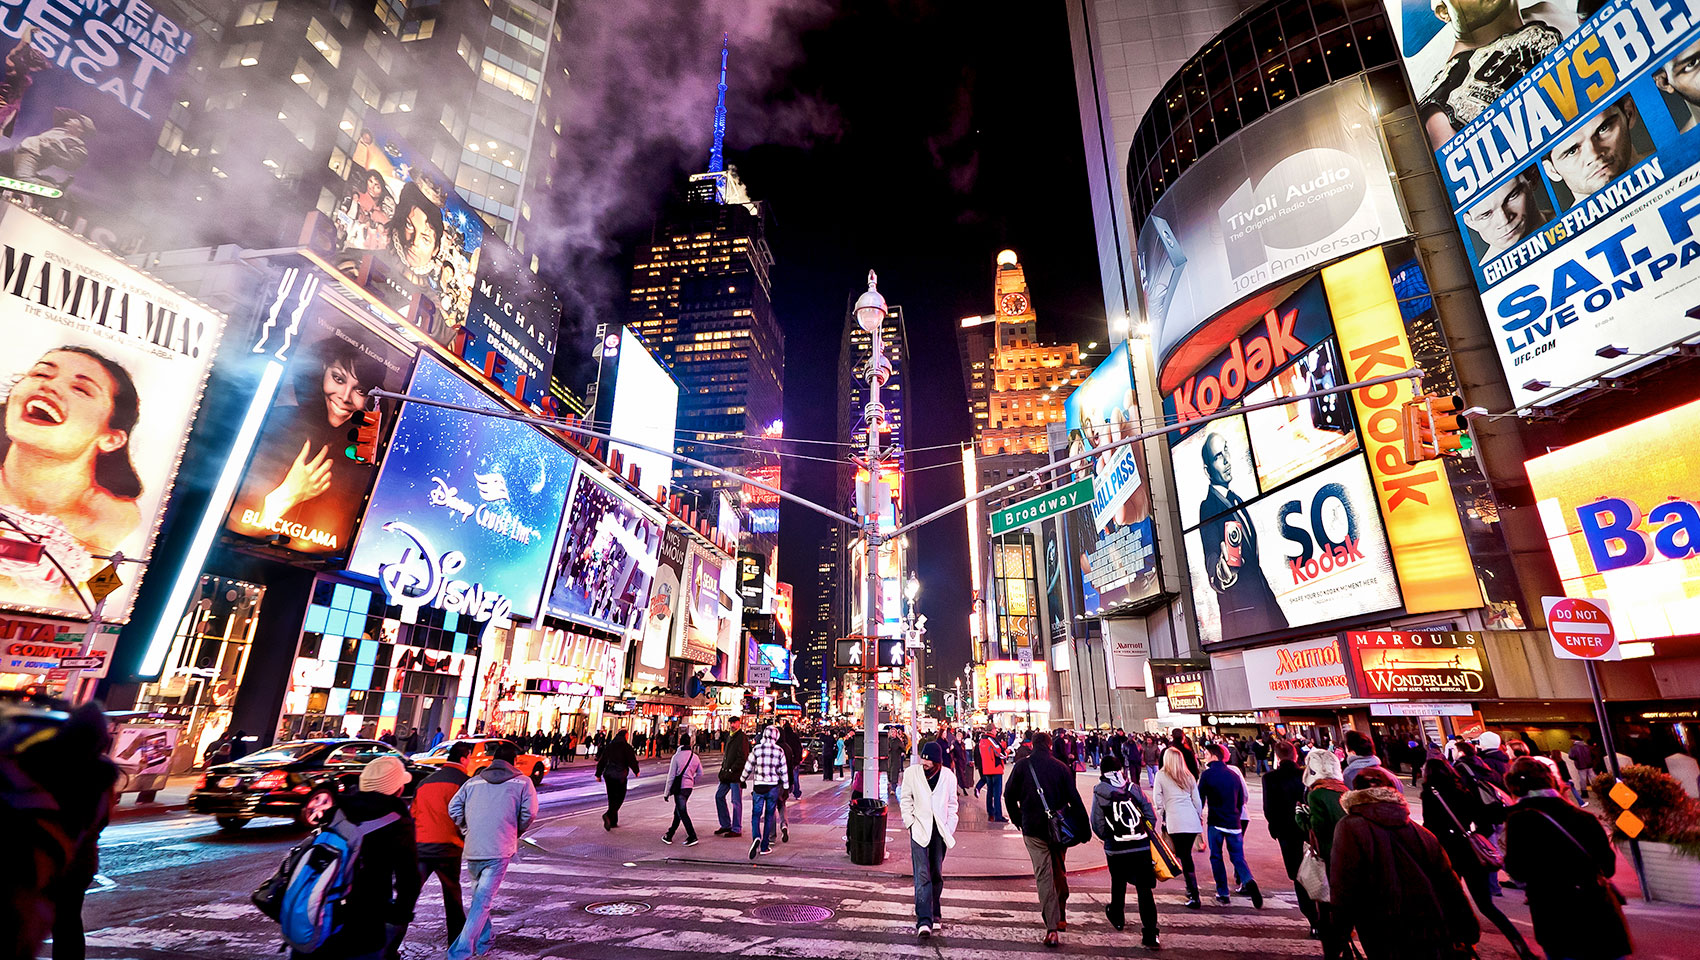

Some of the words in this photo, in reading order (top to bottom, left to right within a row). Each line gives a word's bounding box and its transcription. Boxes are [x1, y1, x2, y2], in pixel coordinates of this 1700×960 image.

[2, 0, 170, 91] EST
[107, 0, 191, 54] ER!
[111, 13, 178, 64] AWARD
[1441, 108, 1496, 156] WORLD
[1446, 86, 1564, 204] SILVA
[1538, 35, 1617, 123] VS
[1227, 194, 1278, 231] Tivoli
[1286, 166, 1351, 204] Audio
[1229, 229, 1244, 242] The
[1245, 214, 1278, 234] Original
[1279, 201, 1305, 217] Radio
[1306, 180, 1354, 204] Company
[1483, 230, 1549, 286] GRIFFIN
[1545, 222, 1568, 247] VS
[1561, 157, 1666, 238] FRANKLIN
[1620, 194, 1664, 223] PRESENTED
[1665, 186, 1676, 196] BY
[1678, 169, 1700, 189] BU
[1232, 270, 1267, 294] 10th
[1270, 226, 1381, 275] Anniversary
[1497, 224, 1652, 332] SAT.
[2, 244, 129, 334] MAMMA
[138, 300, 204, 359] MIA!
[24, 305, 41, 317] THE
[44, 310, 75, 327] SMASH
[479, 280, 554, 354] MICHAEL
[1506, 304, 1579, 354] LIVE
[1584, 270, 1644, 313] ON
[359, 343, 366, 351] A
[483, 313, 501, 335] THE
[501, 328, 521, 350] NEW
[519, 345, 545, 372] ALBUM
[486, 333, 529, 373] DECEMBER
[528, 367, 538, 380] 14
[1514, 339, 1557, 367] UFC.COM
[1173, 307, 1309, 436] Kodak
[1349, 335, 1440, 513] Kodak
[429, 476, 476, 523] Disney
[1005, 489, 1079, 526] Broadway
[1092, 481, 1114, 519] HALL
[1110, 452, 1136, 495] PASS
[241, 508, 338, 549] BLACKGLAMA
[1277, 482, 1360, 568] SO
[1575, 497, 1700, 573] Ba
[661, 539, 685, 565] AMOUS
[1289, 535, 1366, 586] Kodak
[702, 572, 718, 592] SEOUL
[1289, 595, 1303, 604] SHARE
[1304, 592, 1317, 600] YOUR
[1323, 588, 1339, 596] KODAK
[1340, 580, 1363, 592] MOMENT
[1363, 577, 1378, 586] HERE
[1355, 632, 1476, 646] MARQUIS
[1557, 609, 1572, 619] DO
[1575, 610, 1597, 620] NOT
[538, 625, 611, 672] FOREVER
[1116, 642, 1143, 650] Marriott
[1276, 640, 1343, 676] Marriot
[1566, 636, 1602, 647] ENTER
[1165, 673, 1201, 684] MARQUIS
[1269, 680, 1289, 691] NEW
[1290, 678, 1317, 690] YORK
[1317, 675, 1348, 688] MARQ
